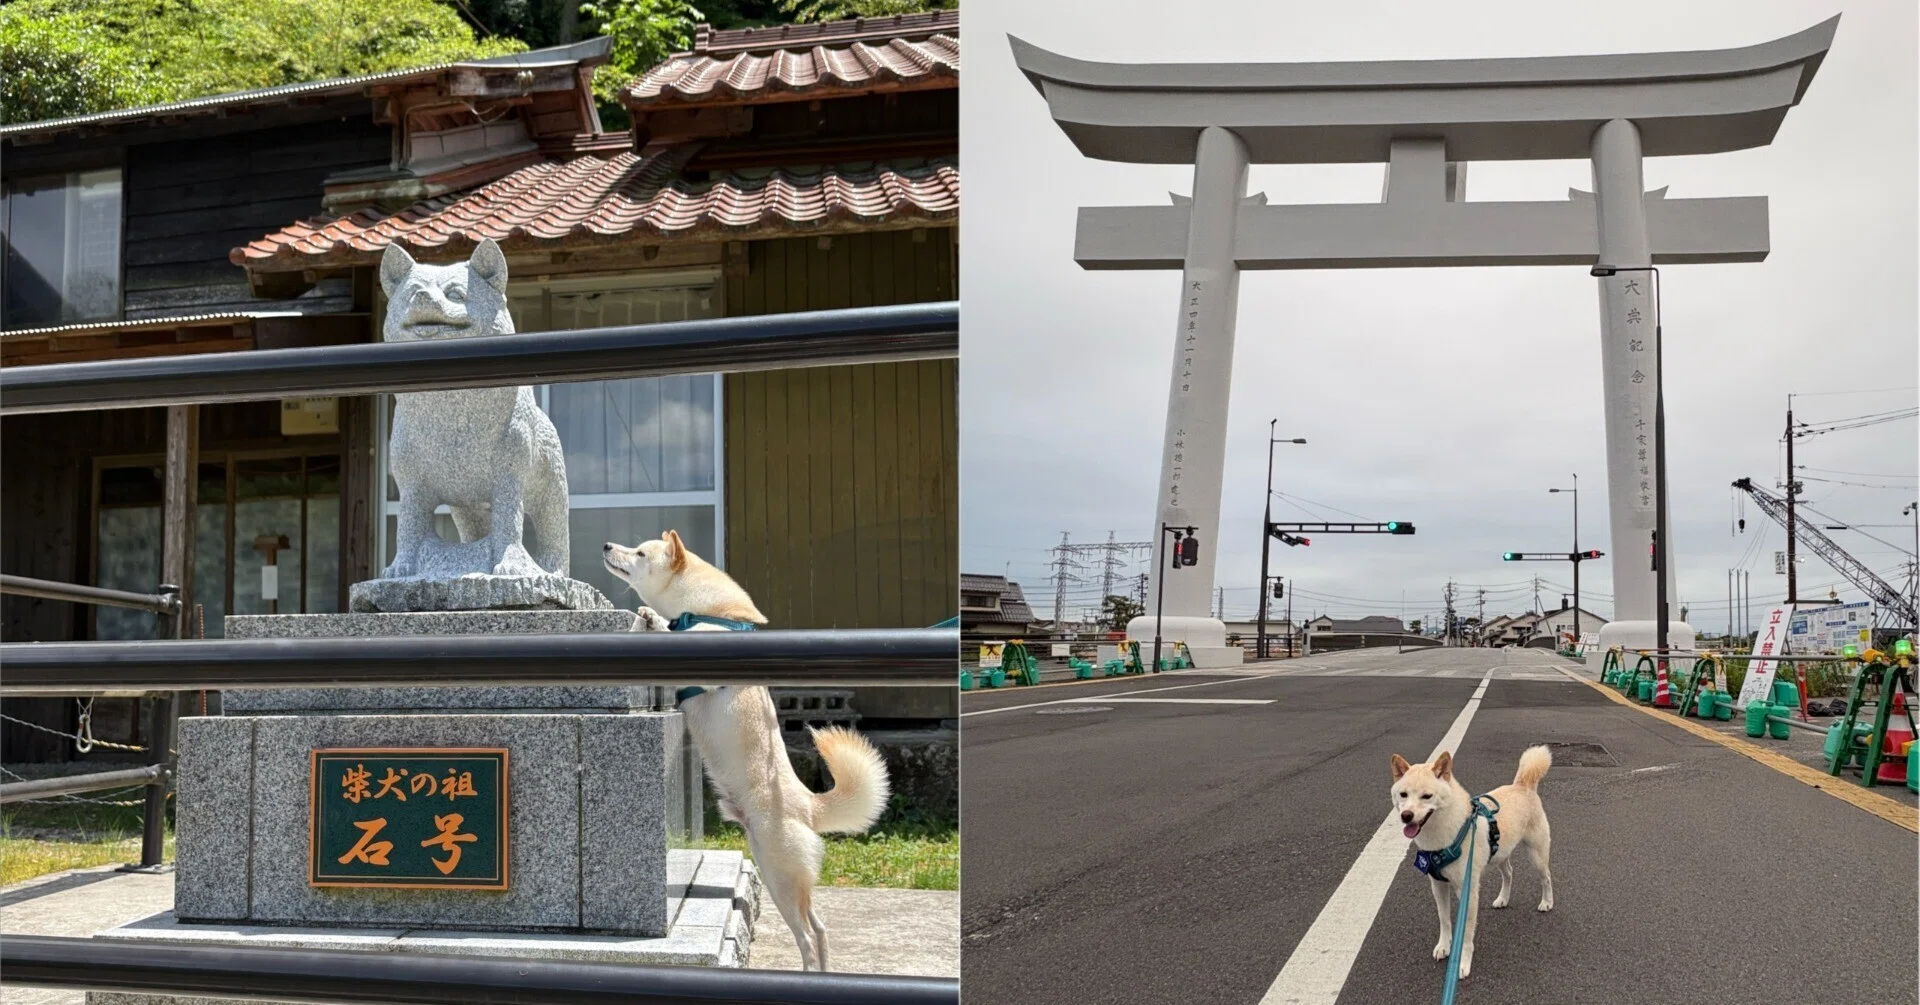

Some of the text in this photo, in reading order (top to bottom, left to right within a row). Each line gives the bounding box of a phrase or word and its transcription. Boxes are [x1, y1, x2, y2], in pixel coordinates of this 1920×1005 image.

[1624, 279, 1646, 384] 大典記念
[1755, 609, 1783, 674] 立入禁止
[341, 764, 478, 803] 柴犬の祖
[337, 813, 478, 875] 石号
